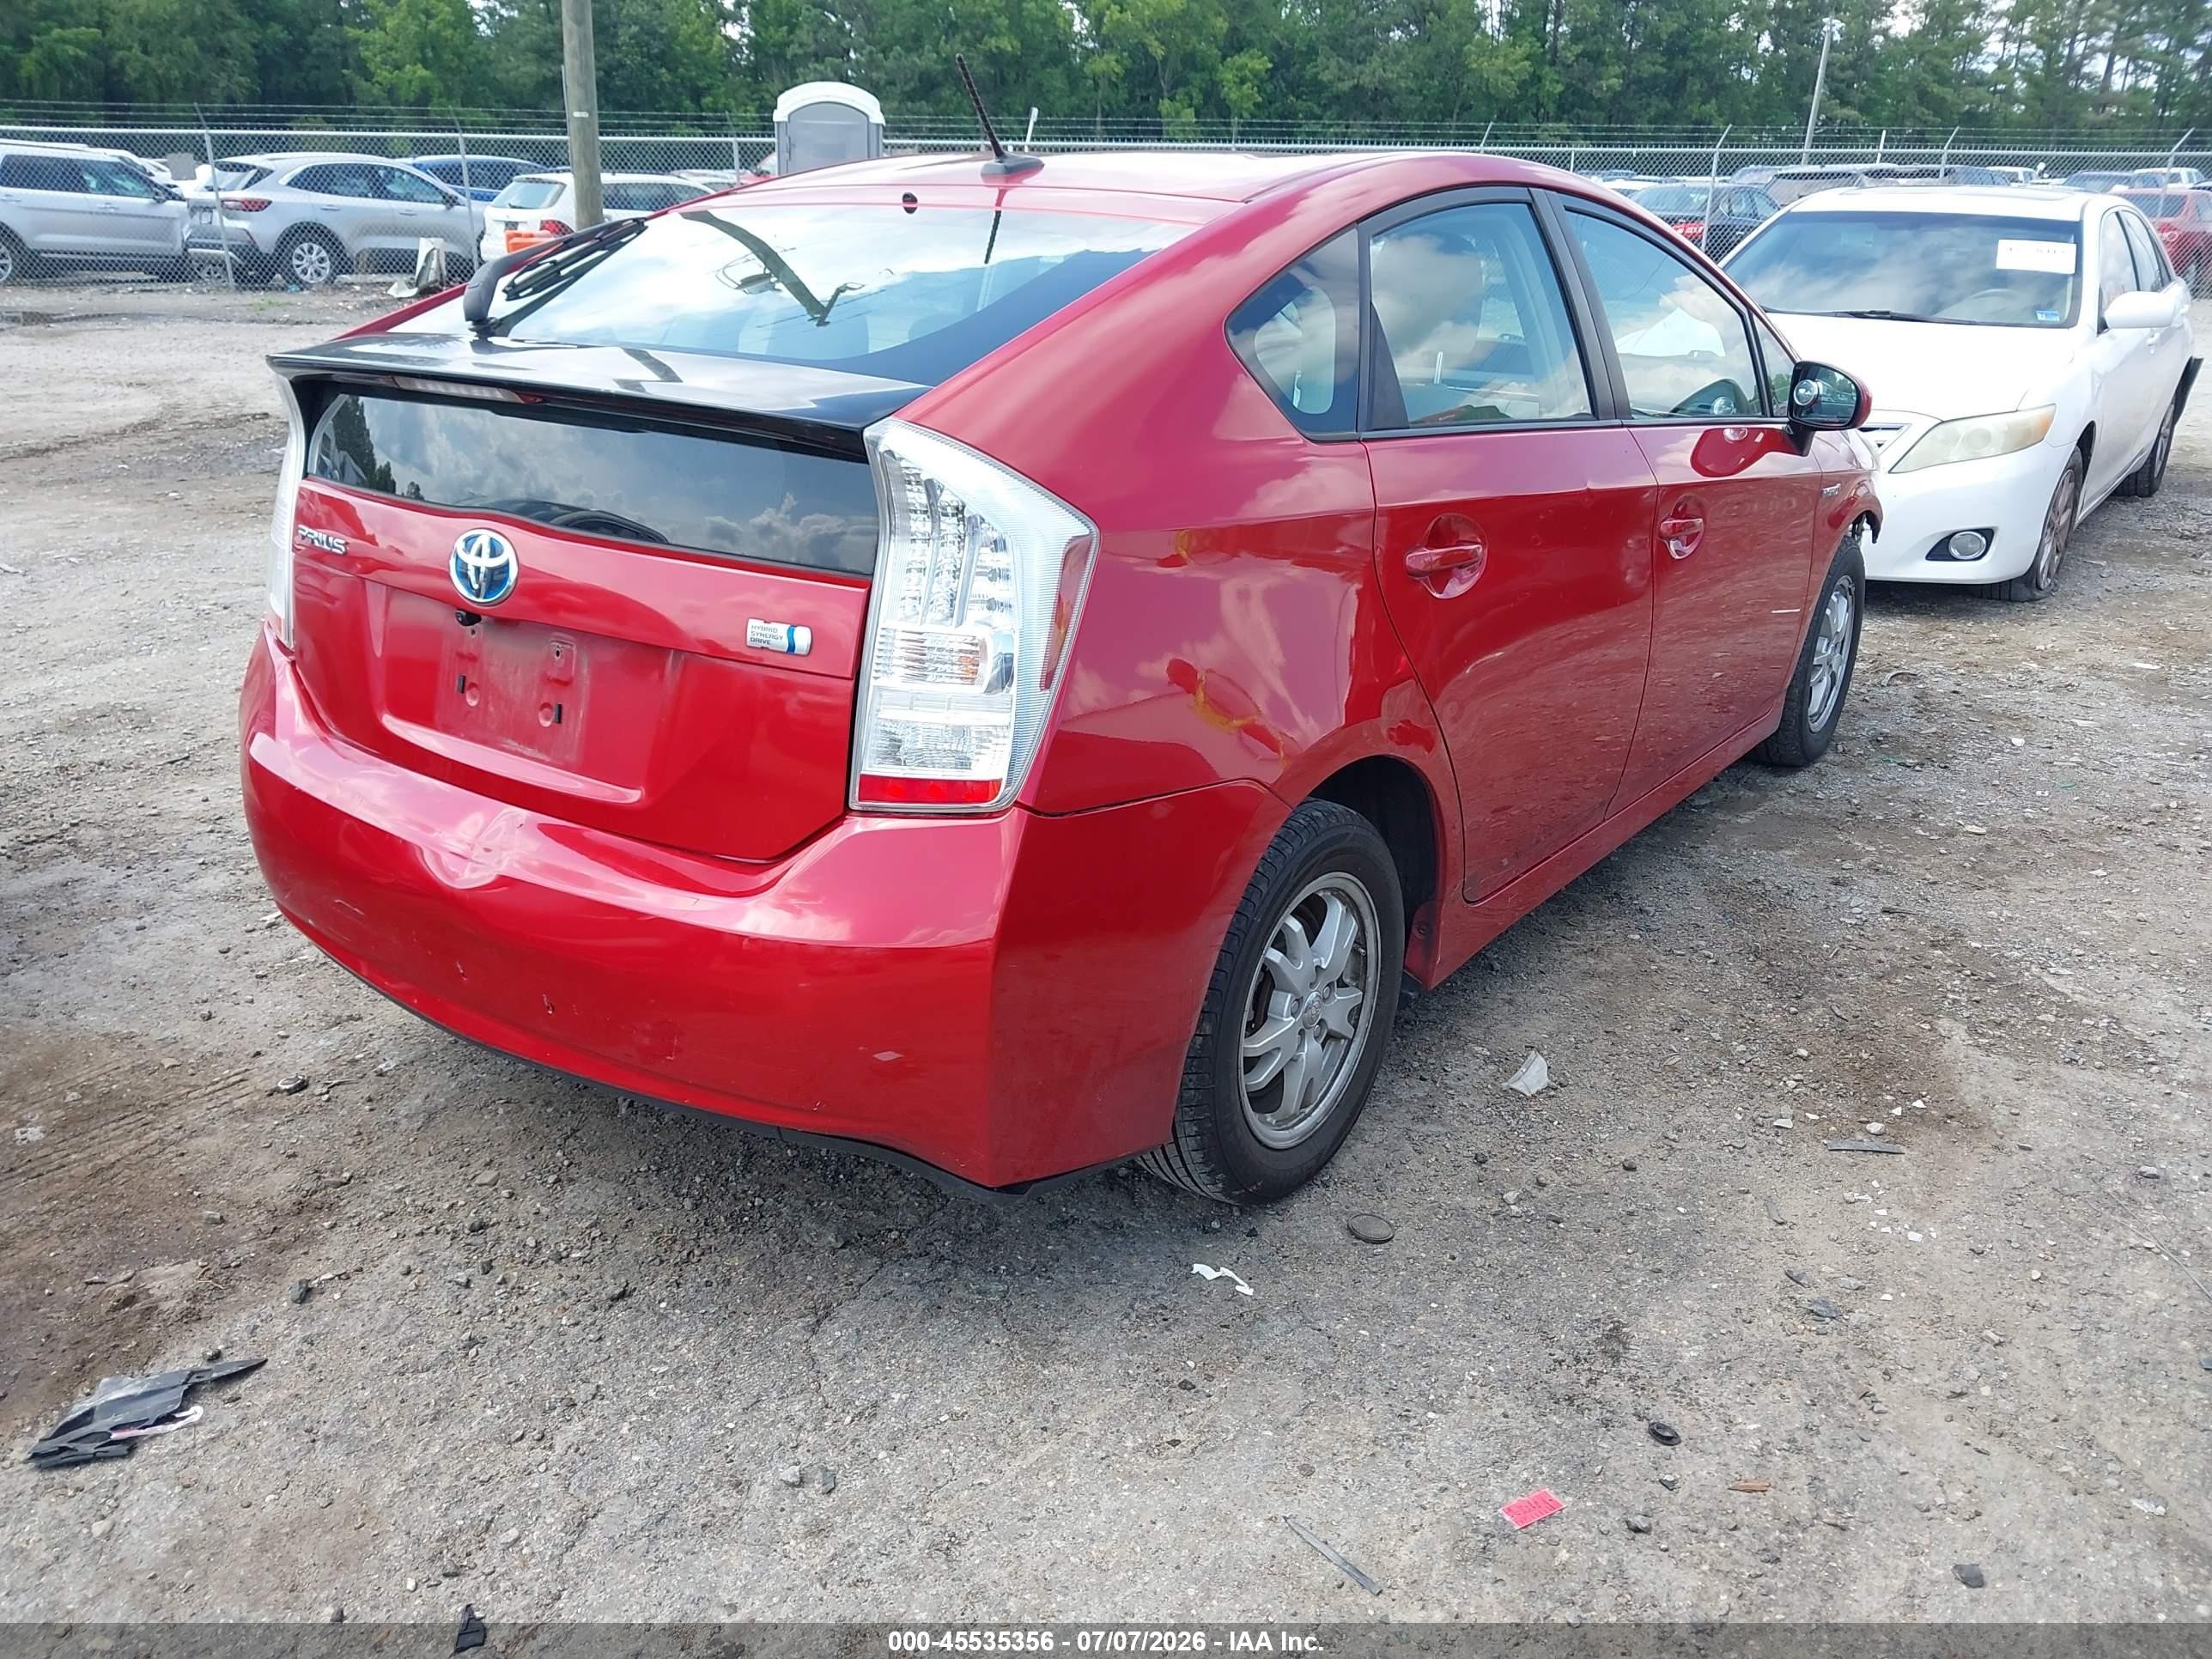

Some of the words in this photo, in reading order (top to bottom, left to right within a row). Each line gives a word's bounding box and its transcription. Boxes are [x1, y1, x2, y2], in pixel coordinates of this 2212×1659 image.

[297, 524, 346, 555] PRIUS
[750, 624, 778, 634] HYBRID
[750, 630, 784, 641] SYNERGY
[750, 636, 772, 646] DRIVE
